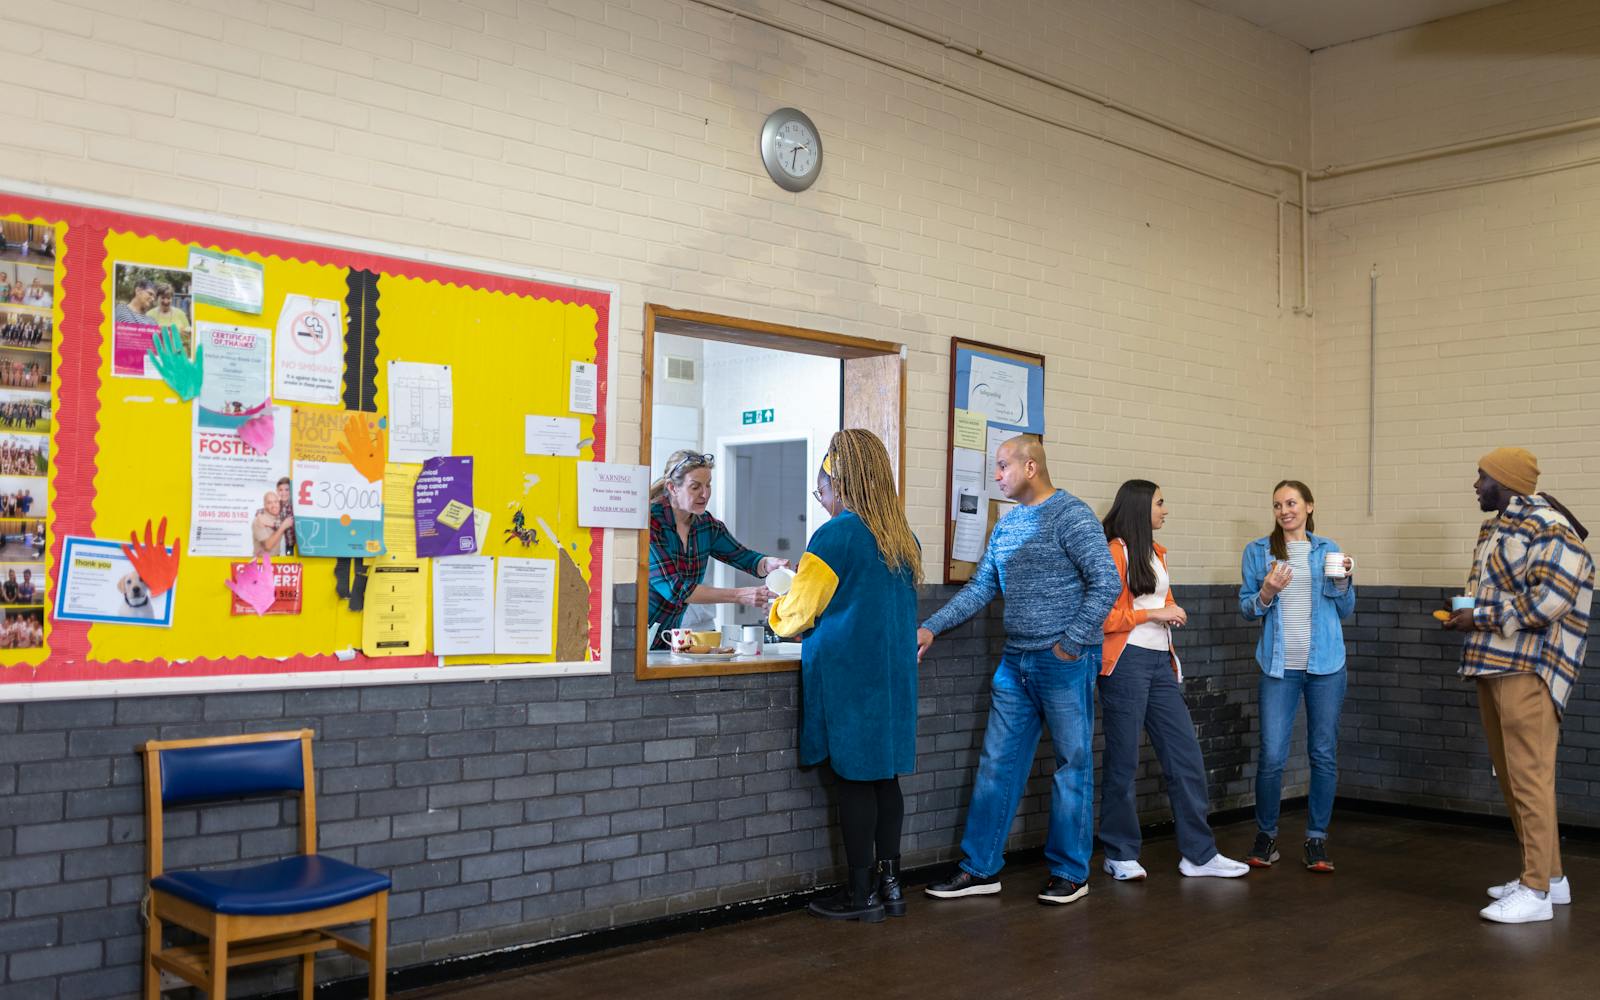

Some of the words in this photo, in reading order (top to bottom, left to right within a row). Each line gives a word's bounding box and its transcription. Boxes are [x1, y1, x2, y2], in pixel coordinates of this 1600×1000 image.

[212, 331, 257, 343] CERTIFICATE
[225, 339, 254, 349] THANKS
[282, 360, 297, 369] NO
[298, 362, 337, 373] SMOKING
[296, 411, 350, 432] THANK
[296, 423, 332, 443] YOU
[200, 438, 267, 456] FOSTE
[75, 559, 96, 568] Thank
[97, 561, 112, 570] you
[276, 564, 298, 574] YOU
